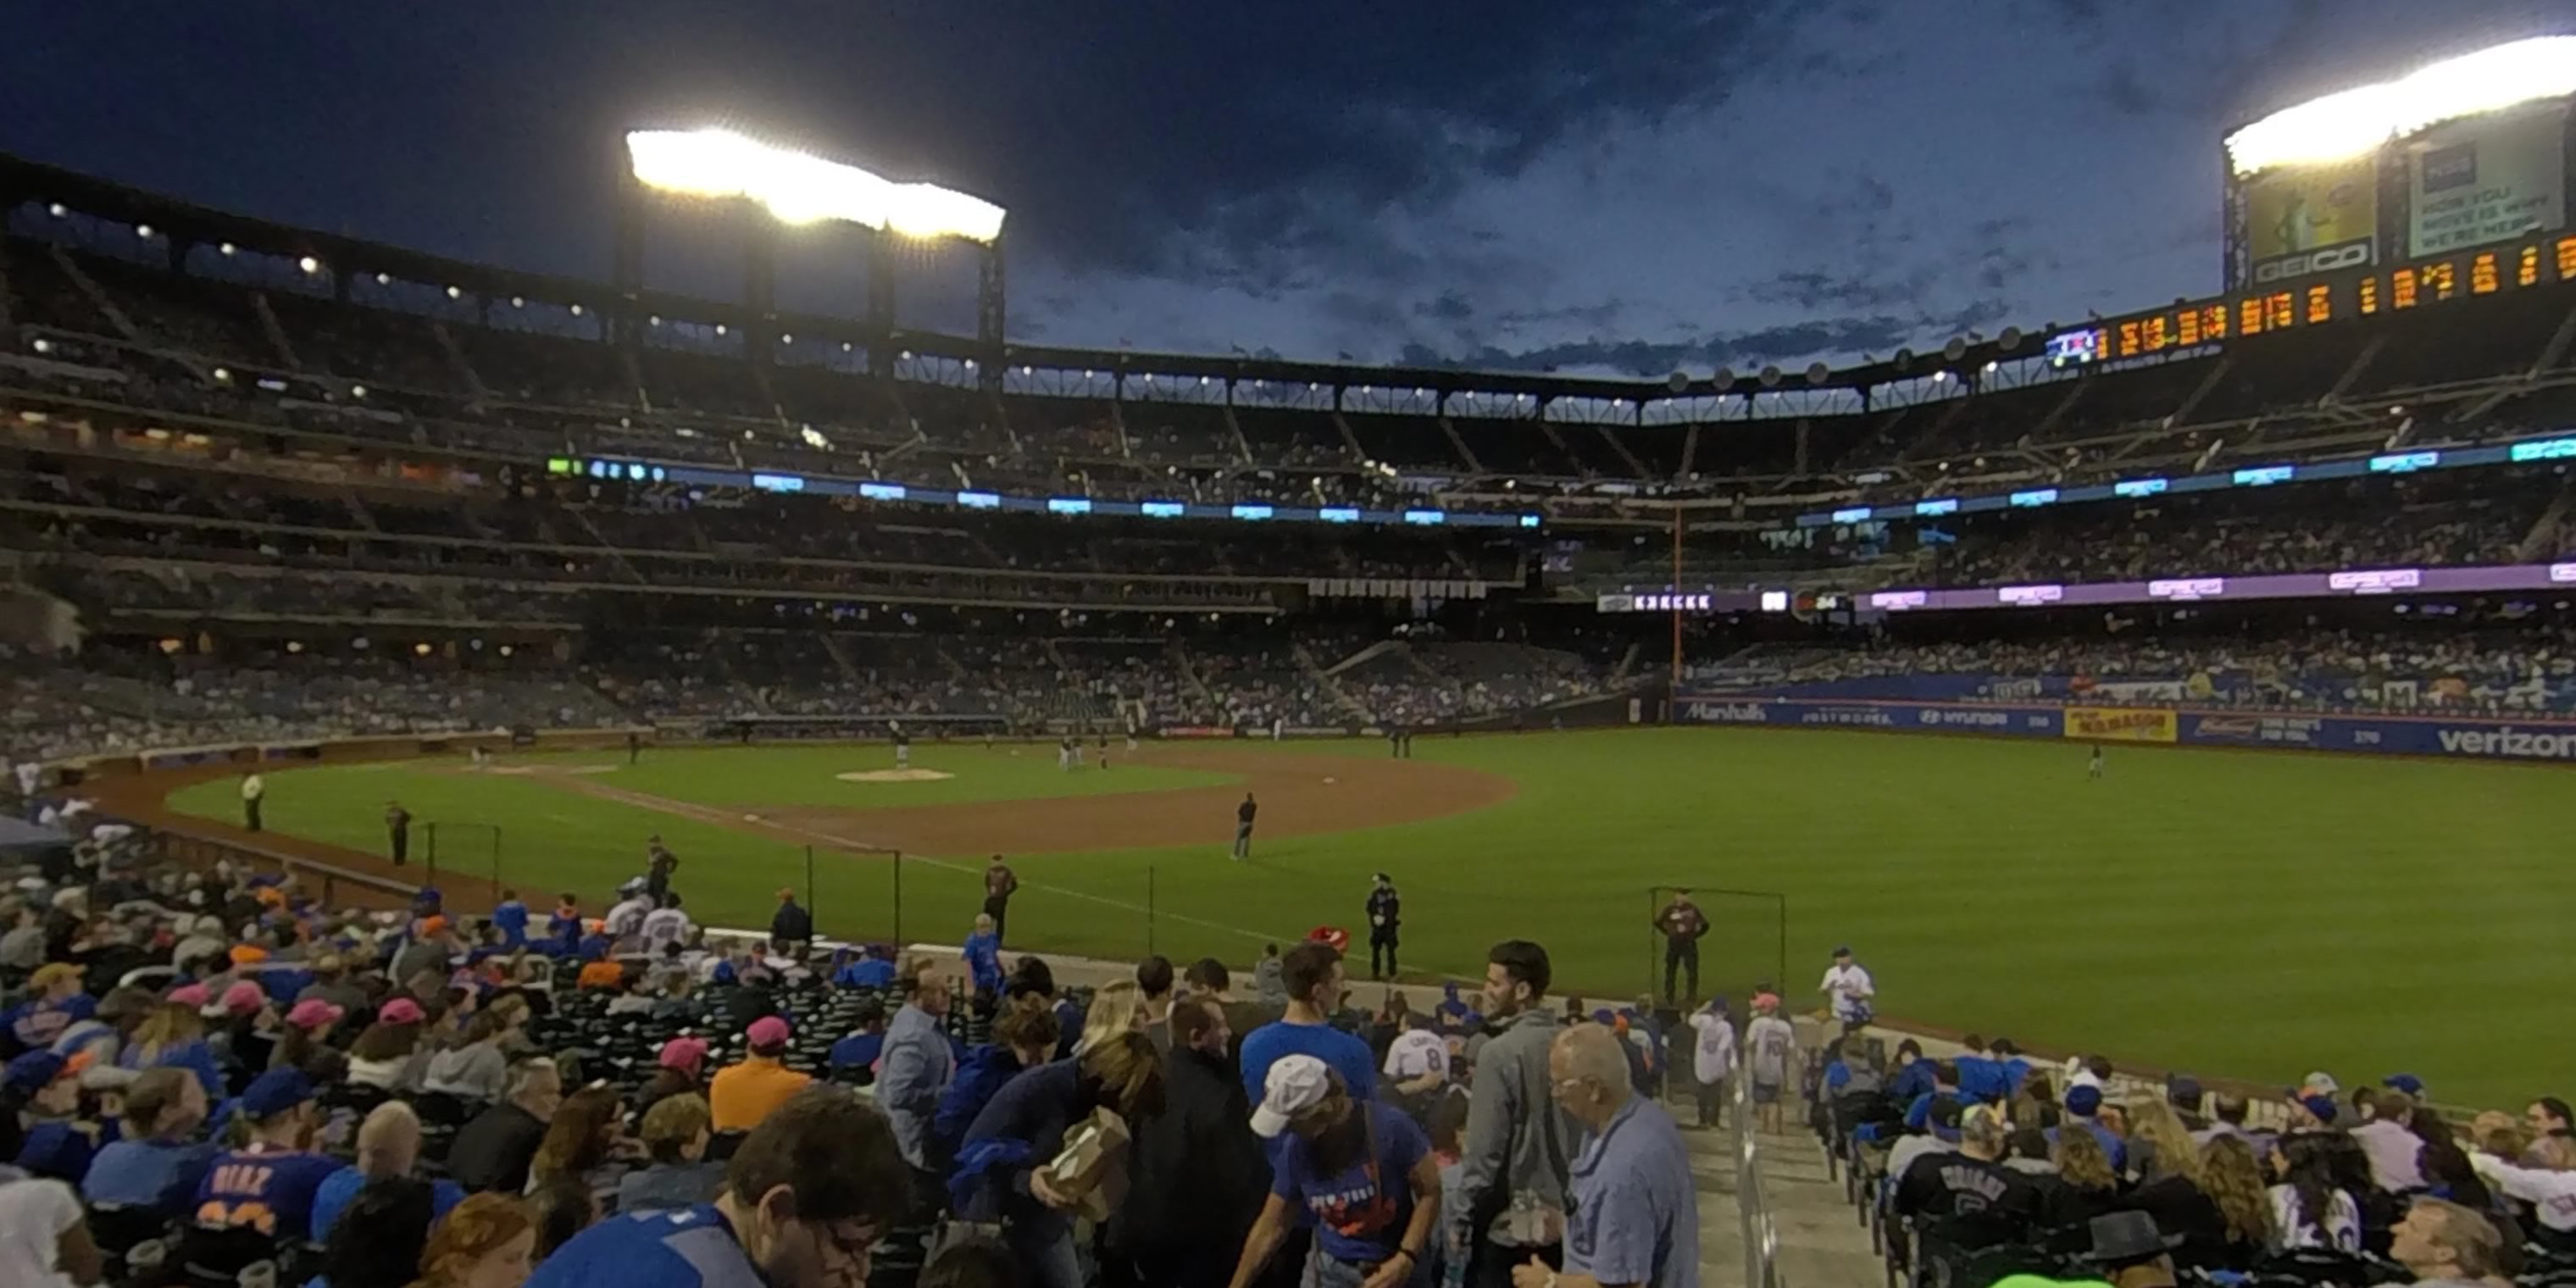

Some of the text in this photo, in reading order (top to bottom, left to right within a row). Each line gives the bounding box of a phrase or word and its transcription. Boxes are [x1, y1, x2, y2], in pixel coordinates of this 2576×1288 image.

[2255, 243, 2368, 283] GEICO
[1685, 702, 1766, 721] Marshalls
[1944, 711, 2007, 725] HYUNDAI
[1425, 1048, 1442, 1072] 8
[211, 1164, 274, 1196] DIAZ
